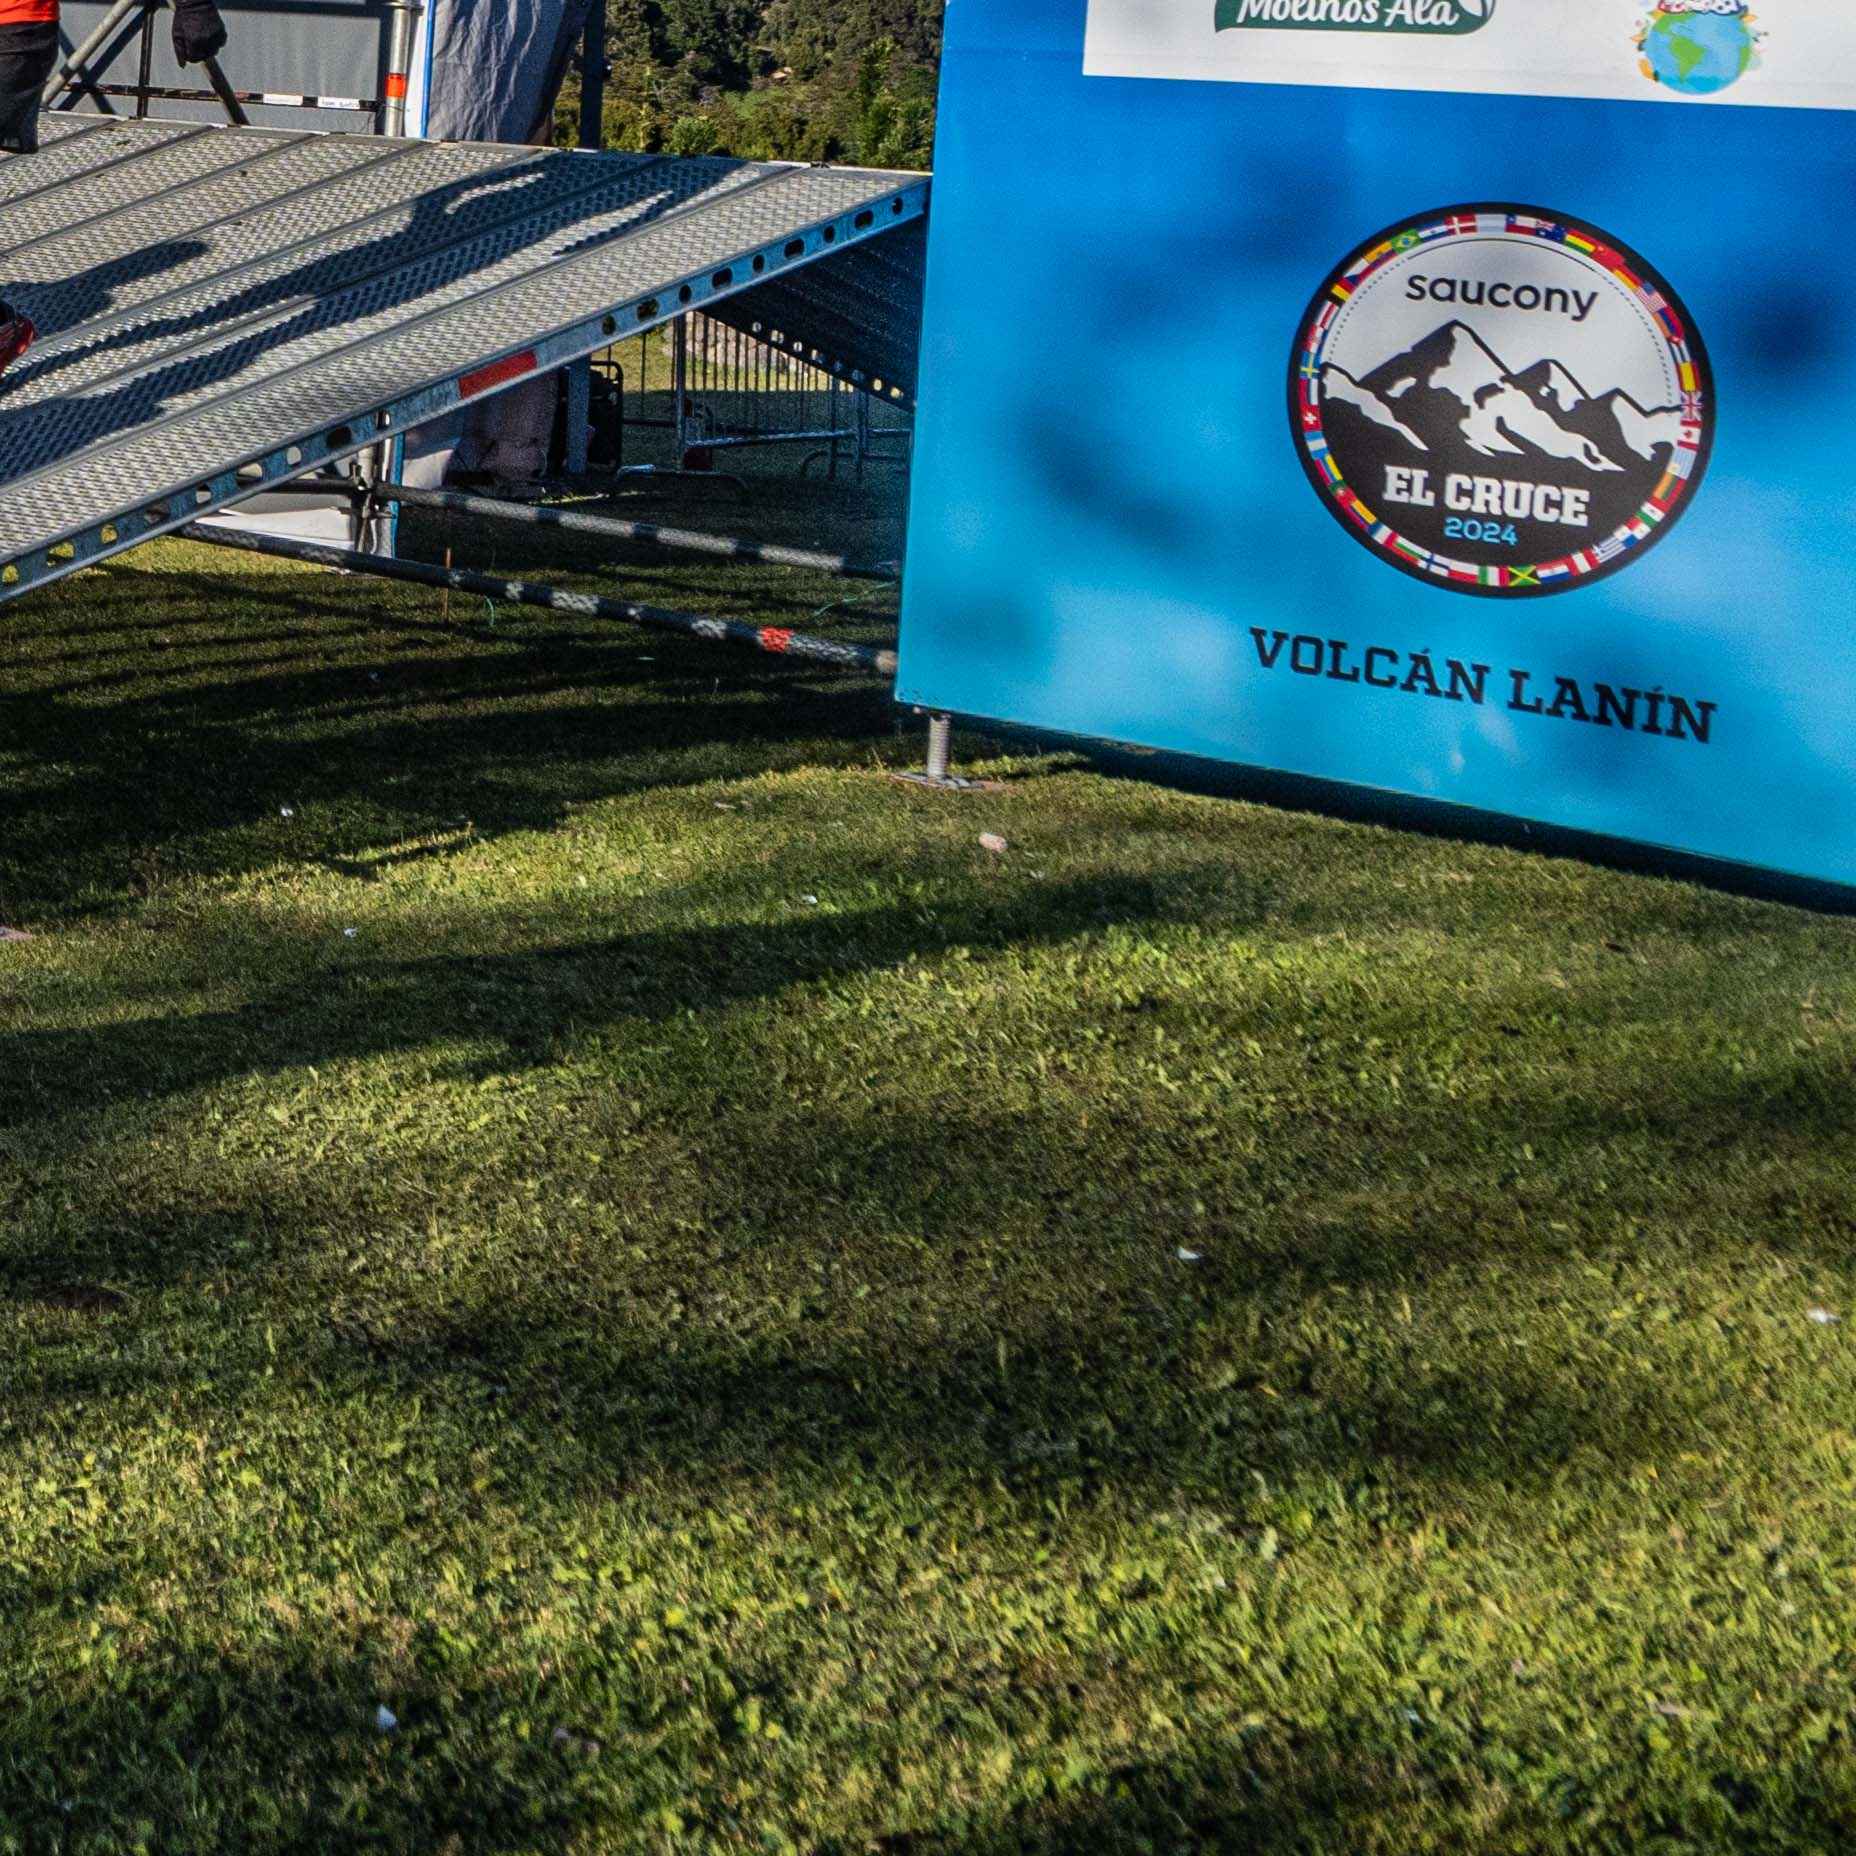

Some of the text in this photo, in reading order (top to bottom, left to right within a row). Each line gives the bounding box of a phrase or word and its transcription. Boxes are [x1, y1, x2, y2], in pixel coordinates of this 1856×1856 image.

[1405, 274, 1600, 322] saucony
[1382, 464, 1590, 527] EL CRUCE
[1443, 516, 1518, 546] 2024
[1249, 626, 1718, 744] VOLCÁN LANÍN
